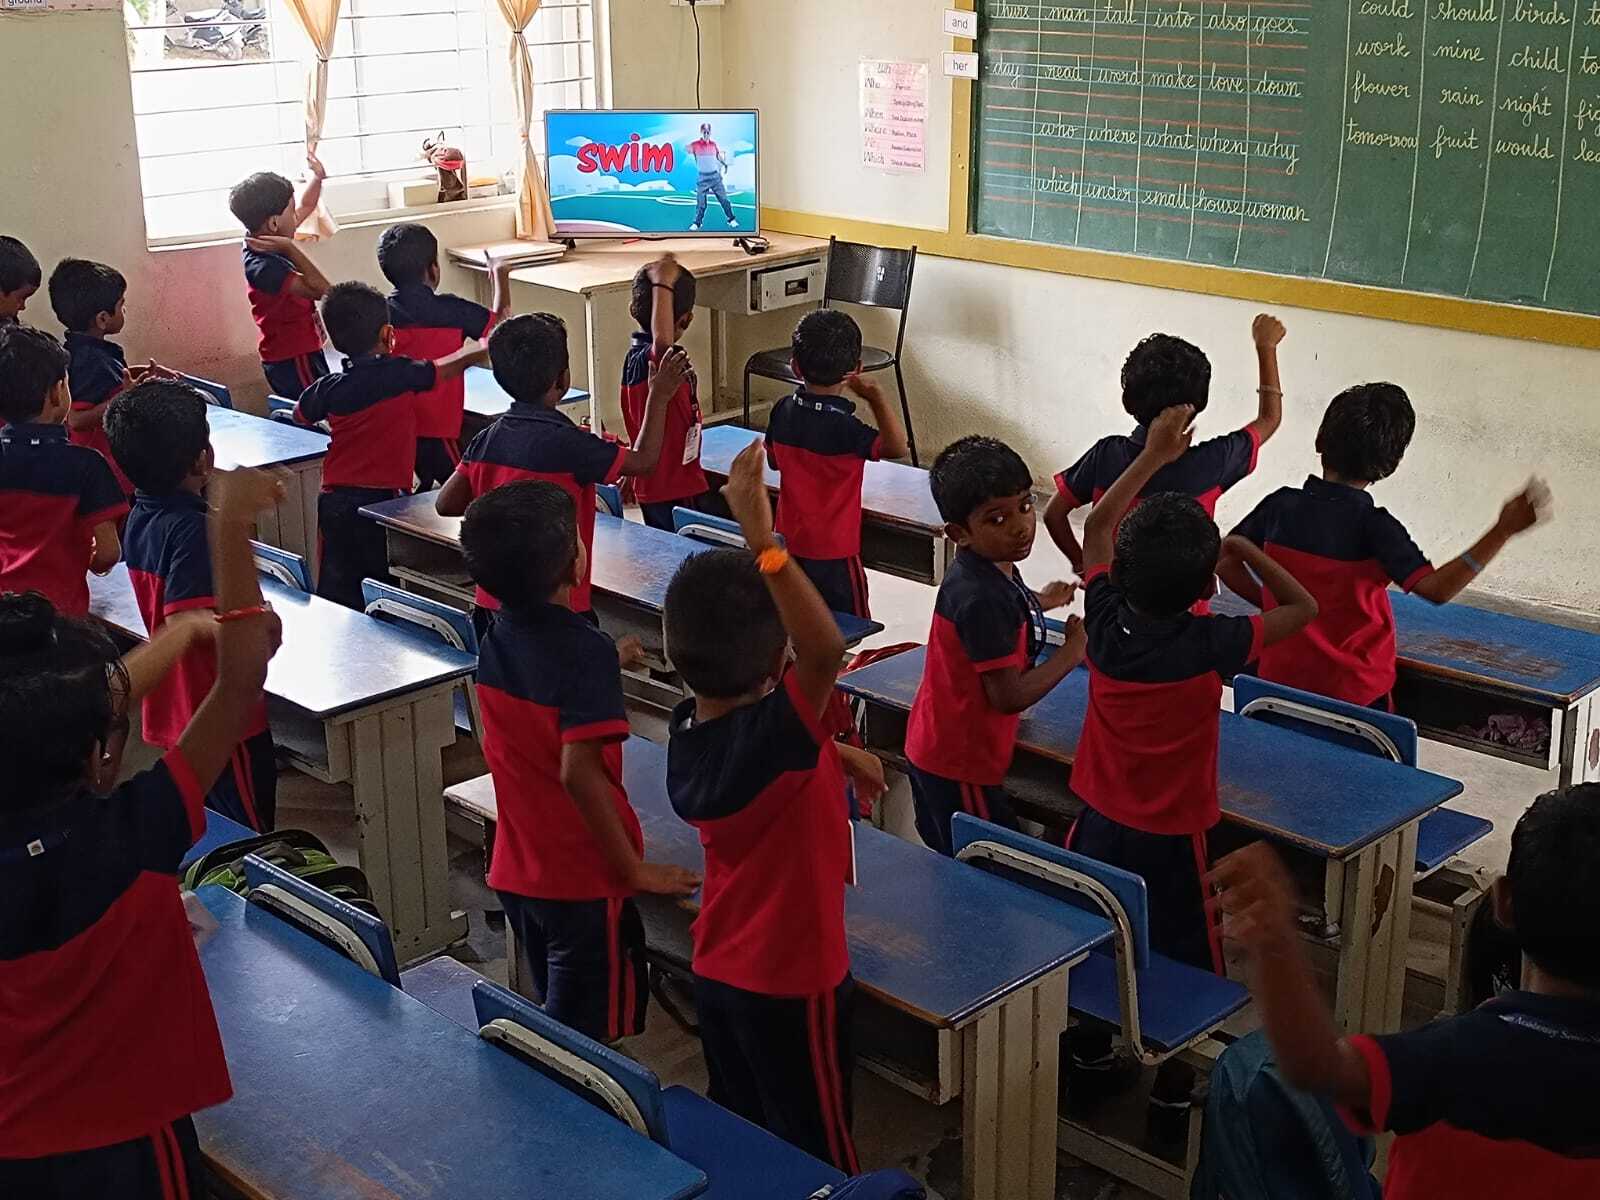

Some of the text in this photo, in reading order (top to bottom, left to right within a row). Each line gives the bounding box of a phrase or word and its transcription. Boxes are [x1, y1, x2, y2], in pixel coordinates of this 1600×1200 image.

[951, 18, 969, 30] and
[1045, 7, 1088, 21] man
[1103, 0, 1136, 24] tall
[1154, 2, 1195, 28] into
[1205, 3, 1247, 31] also
[1252, 15, 1298, 46] goes
[1358, 0, 1415, 19] could
[1431, 0, 1497, 22] should
[1511, 0, 1570, 25] birds
[952, 60, 968, 71] her
[993, 52, 1302, 97] day read word make love down
[1354, 32, 1410, 57] work
[1433, 39, 1485, 62] mine
[1508, 46, 1565, 74] child
[1352, 70, 1411, 104] flower
[1439, 86, 1484, 107] rain
[1499, 92, 1552, 127] night
[576, 132, 674, 174] swim
[1039, 111, 1300, 175] who where what when why
[1345, 117, 1418, 149] tomorrow
[1429, 125, 1479, 159] fruit
[1495, 133, 1554, 160] would
[1036, 166, 1310, 222] which under small house woman
